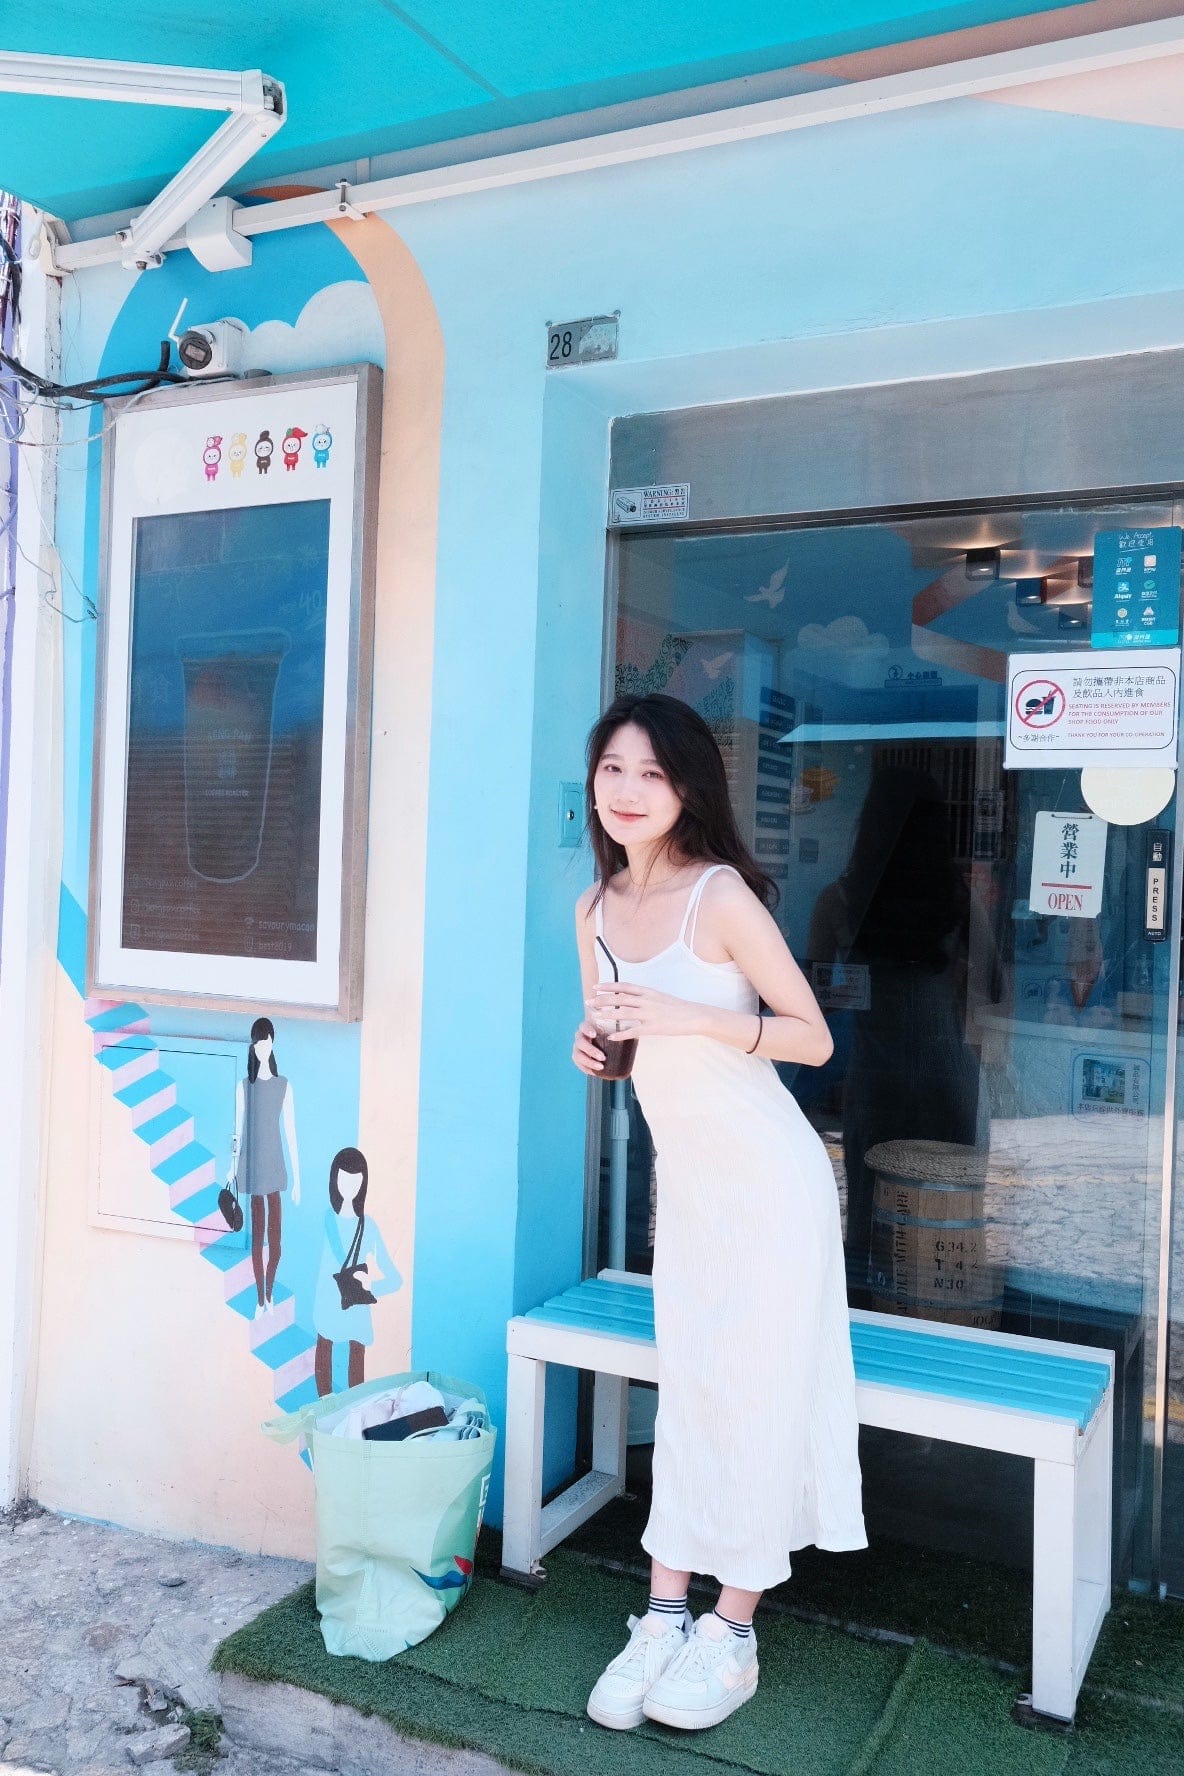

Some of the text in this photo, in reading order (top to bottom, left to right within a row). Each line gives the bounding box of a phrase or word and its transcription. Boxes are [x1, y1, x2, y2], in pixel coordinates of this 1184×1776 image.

[550, 331, 572, 360] 28
[1073, 676, 1165, 687] 請勿攜帶非本店商品
[1060, 823, 1080, 879] 營業中
[1048, 892, 1083, 911] OPEN
